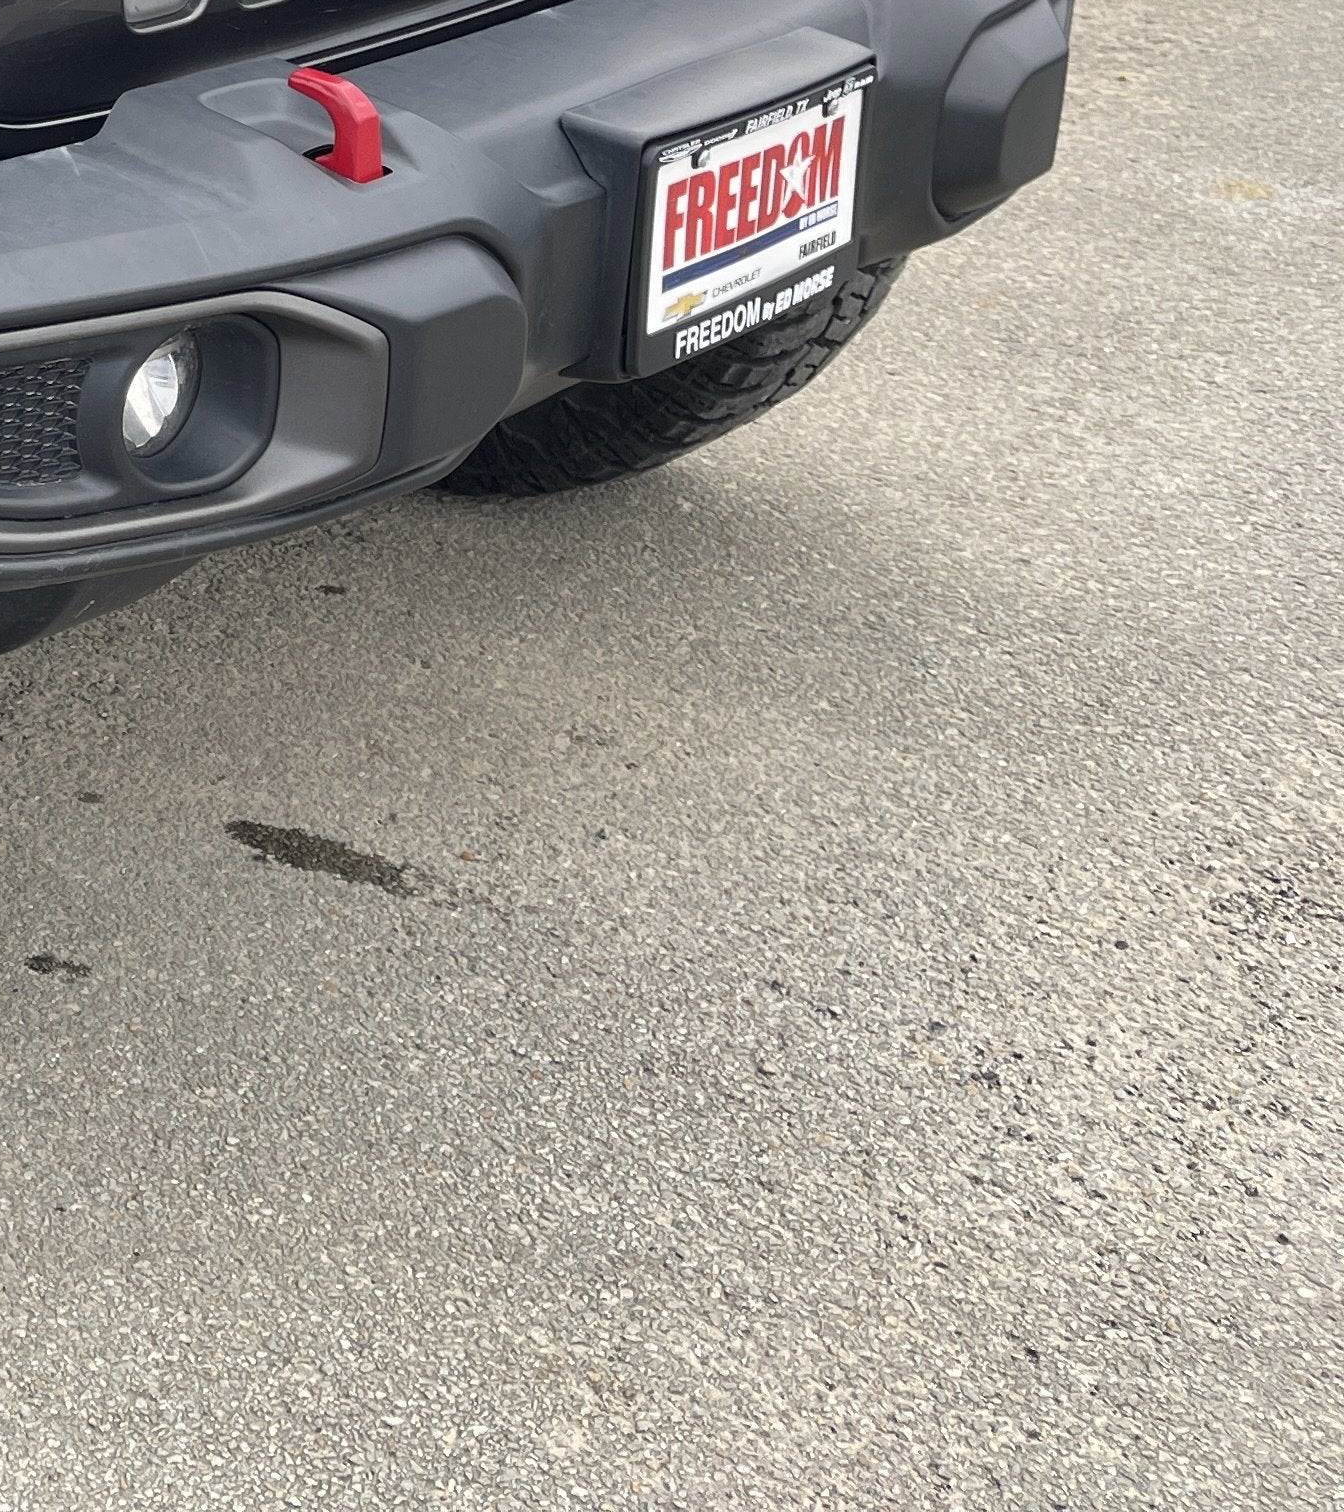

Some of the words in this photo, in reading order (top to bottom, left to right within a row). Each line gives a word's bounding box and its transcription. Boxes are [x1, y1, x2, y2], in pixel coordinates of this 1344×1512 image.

[796, 98, 809, 115] TX
[662, 116, 845, 271] FREEDOM
[799, 230, 837, 260] FAIRFIELD
[712, 268, 761, 299] CHEVROLET
[674, 297, 761, 359] FREEDOM
[775, 288, 792, 315] ED
[792, 265, 835, 306] MORSE
